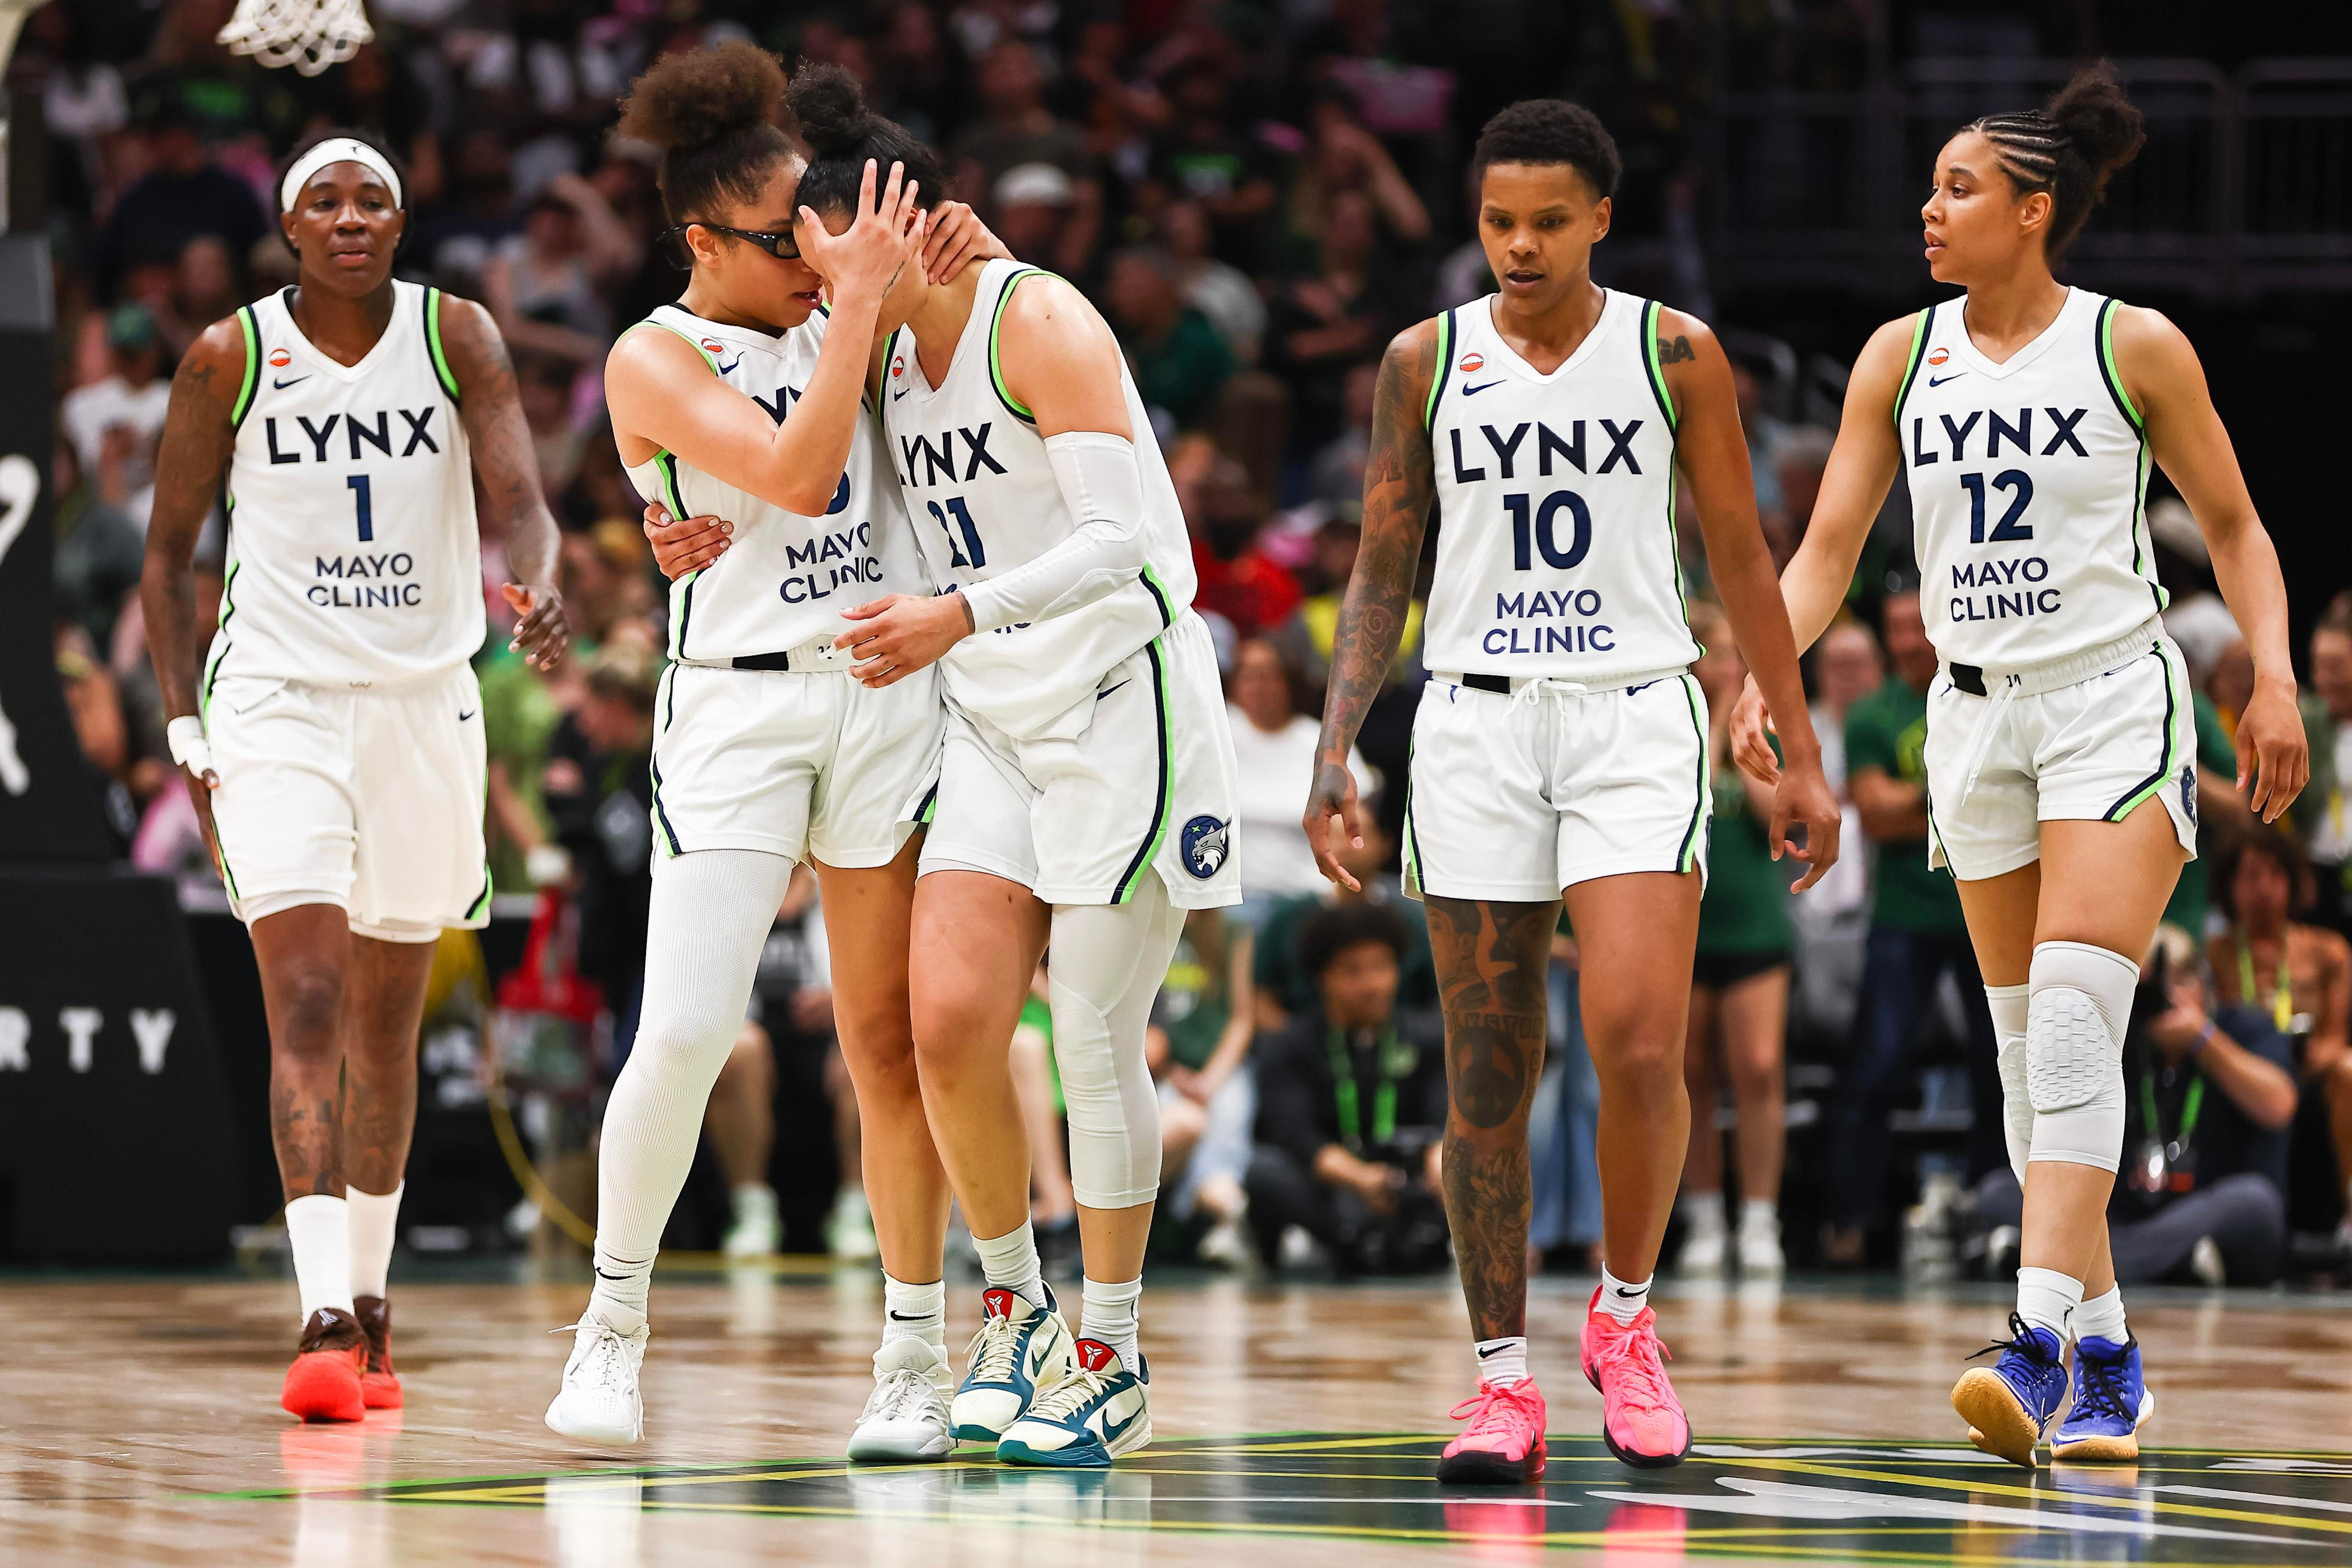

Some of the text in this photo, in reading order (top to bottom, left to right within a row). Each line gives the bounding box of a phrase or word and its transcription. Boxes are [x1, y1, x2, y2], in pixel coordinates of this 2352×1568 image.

[265, 406, 440, 465] LYNX
[899, 422, 1008, 488] YNX
[1450, 419, 1645, 484] LYNX
[1914, 407, 2090, 467] LYNX
[347, 474, 374, 542] 1
[927, 496, 986, 569] 21
[1503, 490, 1592, 571] 10
[1959, 469, 2034, 544] 12
[316, 553, 413, 578] MAYO
[785, 521, 871, 570] MAYO
[1952, 557, 2048, 589] MAYO
[307, 583, 421, 608] CLINIC
[780, 556, 884, 604] CLINIC
[1497, 589, 1602, 619] MAYO
[1950, 589, 2061, 622] CLINIC
[1483, 625, 1616, 655] CLINIC
[0, 1006, 176, 1074] RTY
